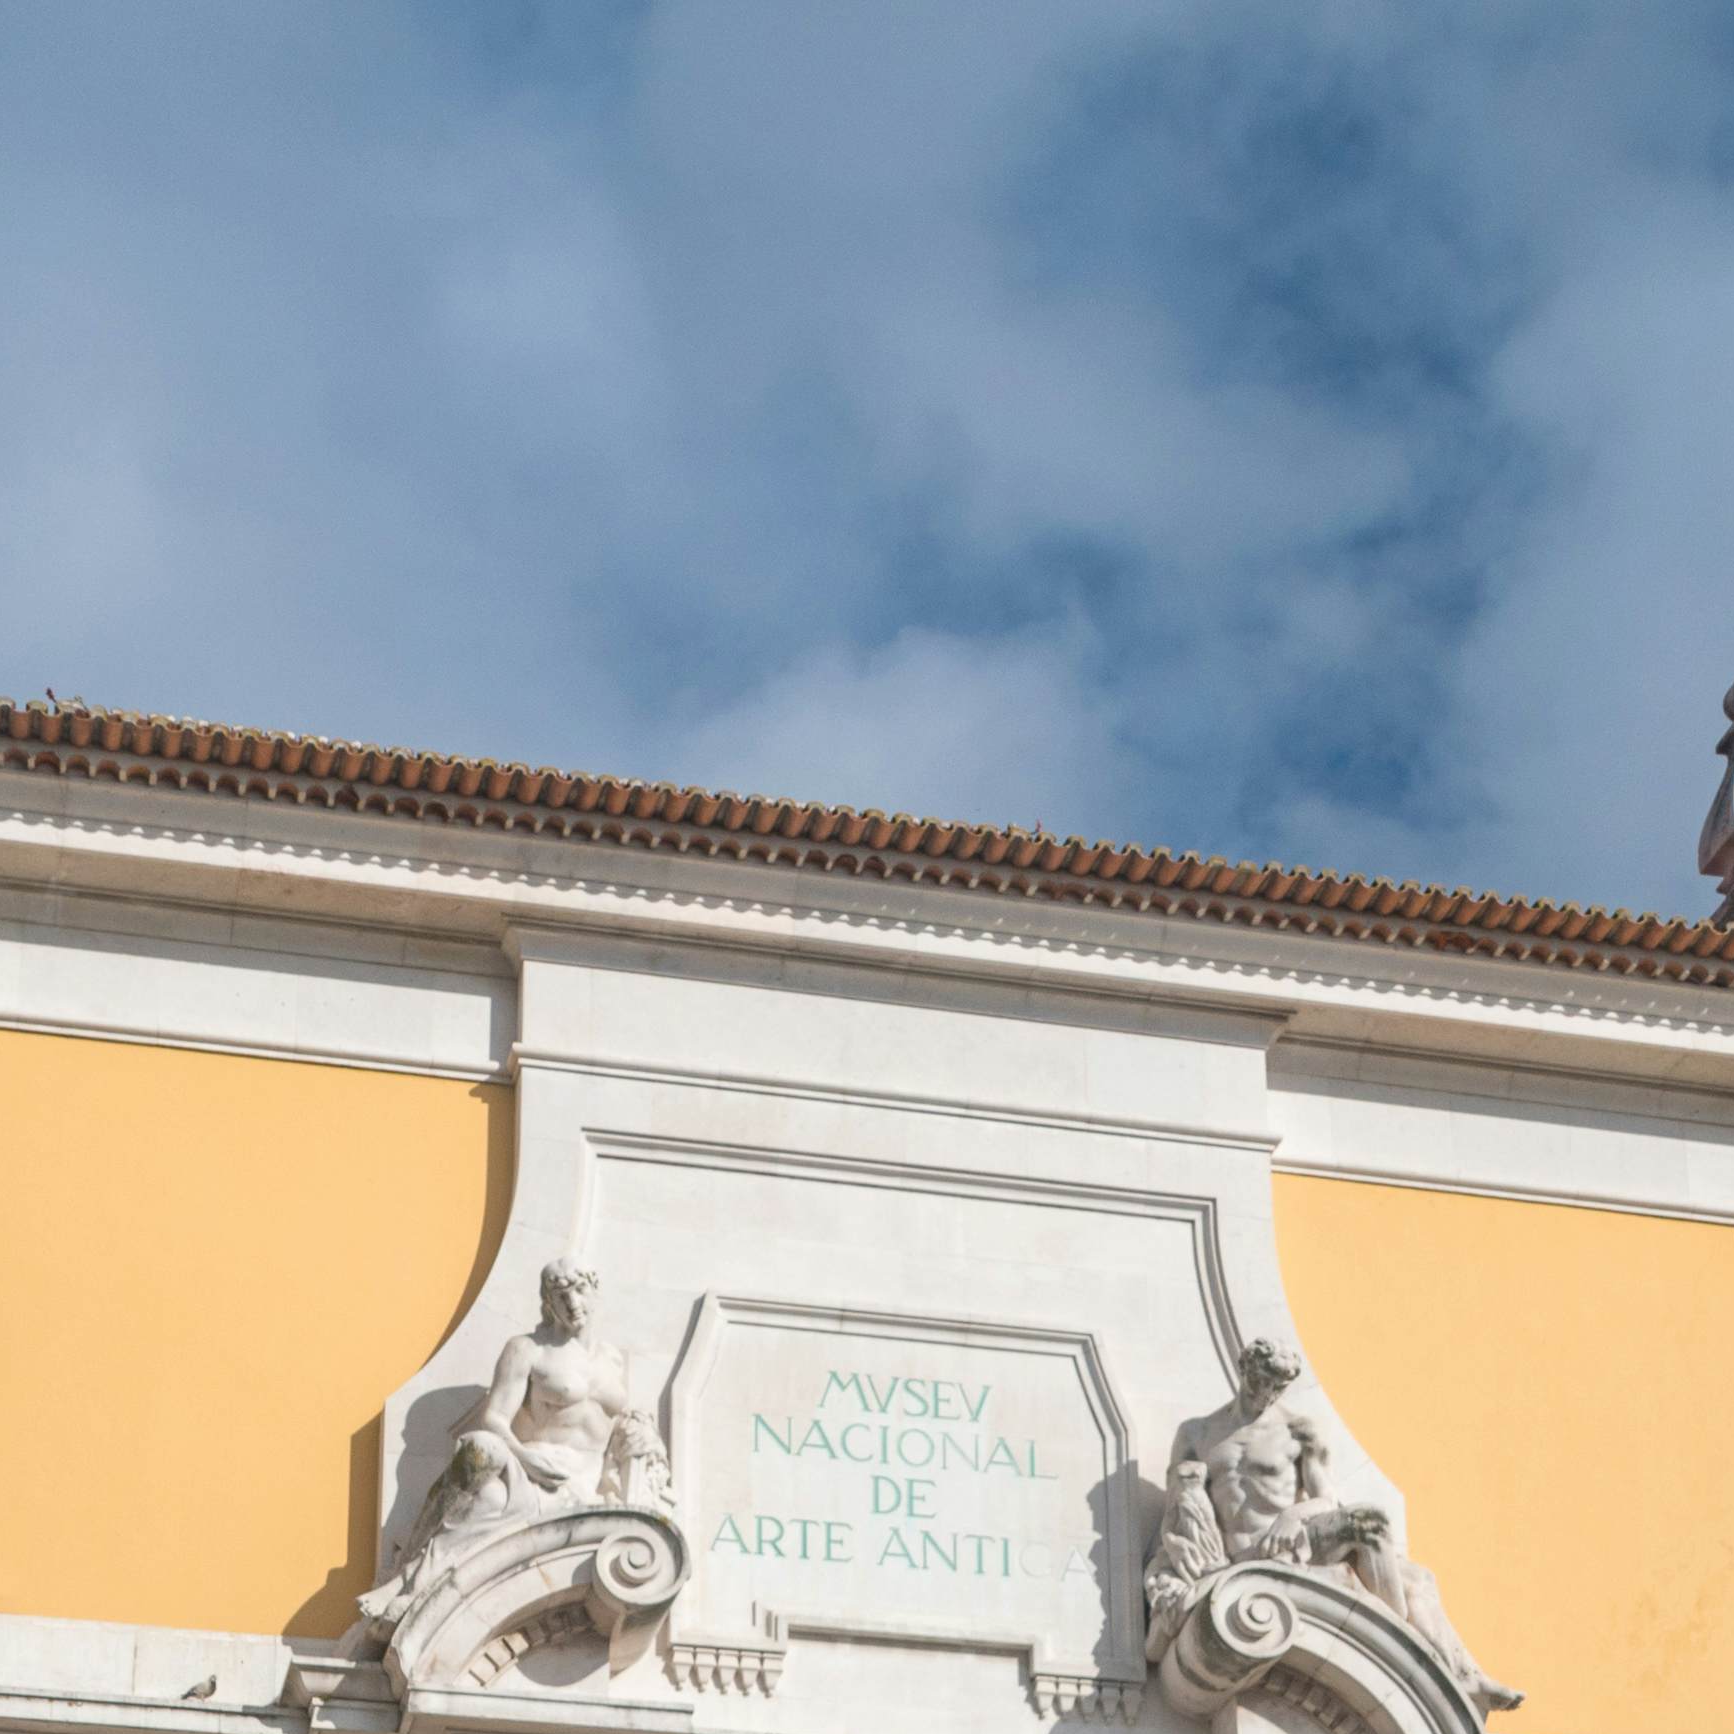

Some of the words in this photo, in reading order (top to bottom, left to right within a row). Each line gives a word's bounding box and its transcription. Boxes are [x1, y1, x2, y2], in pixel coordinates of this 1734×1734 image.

[752, 1413, 1059, 1481] NACIONAL
[870, 1475, 938, 1520] DE
[710, 1512, 852, 1564] ARTE
